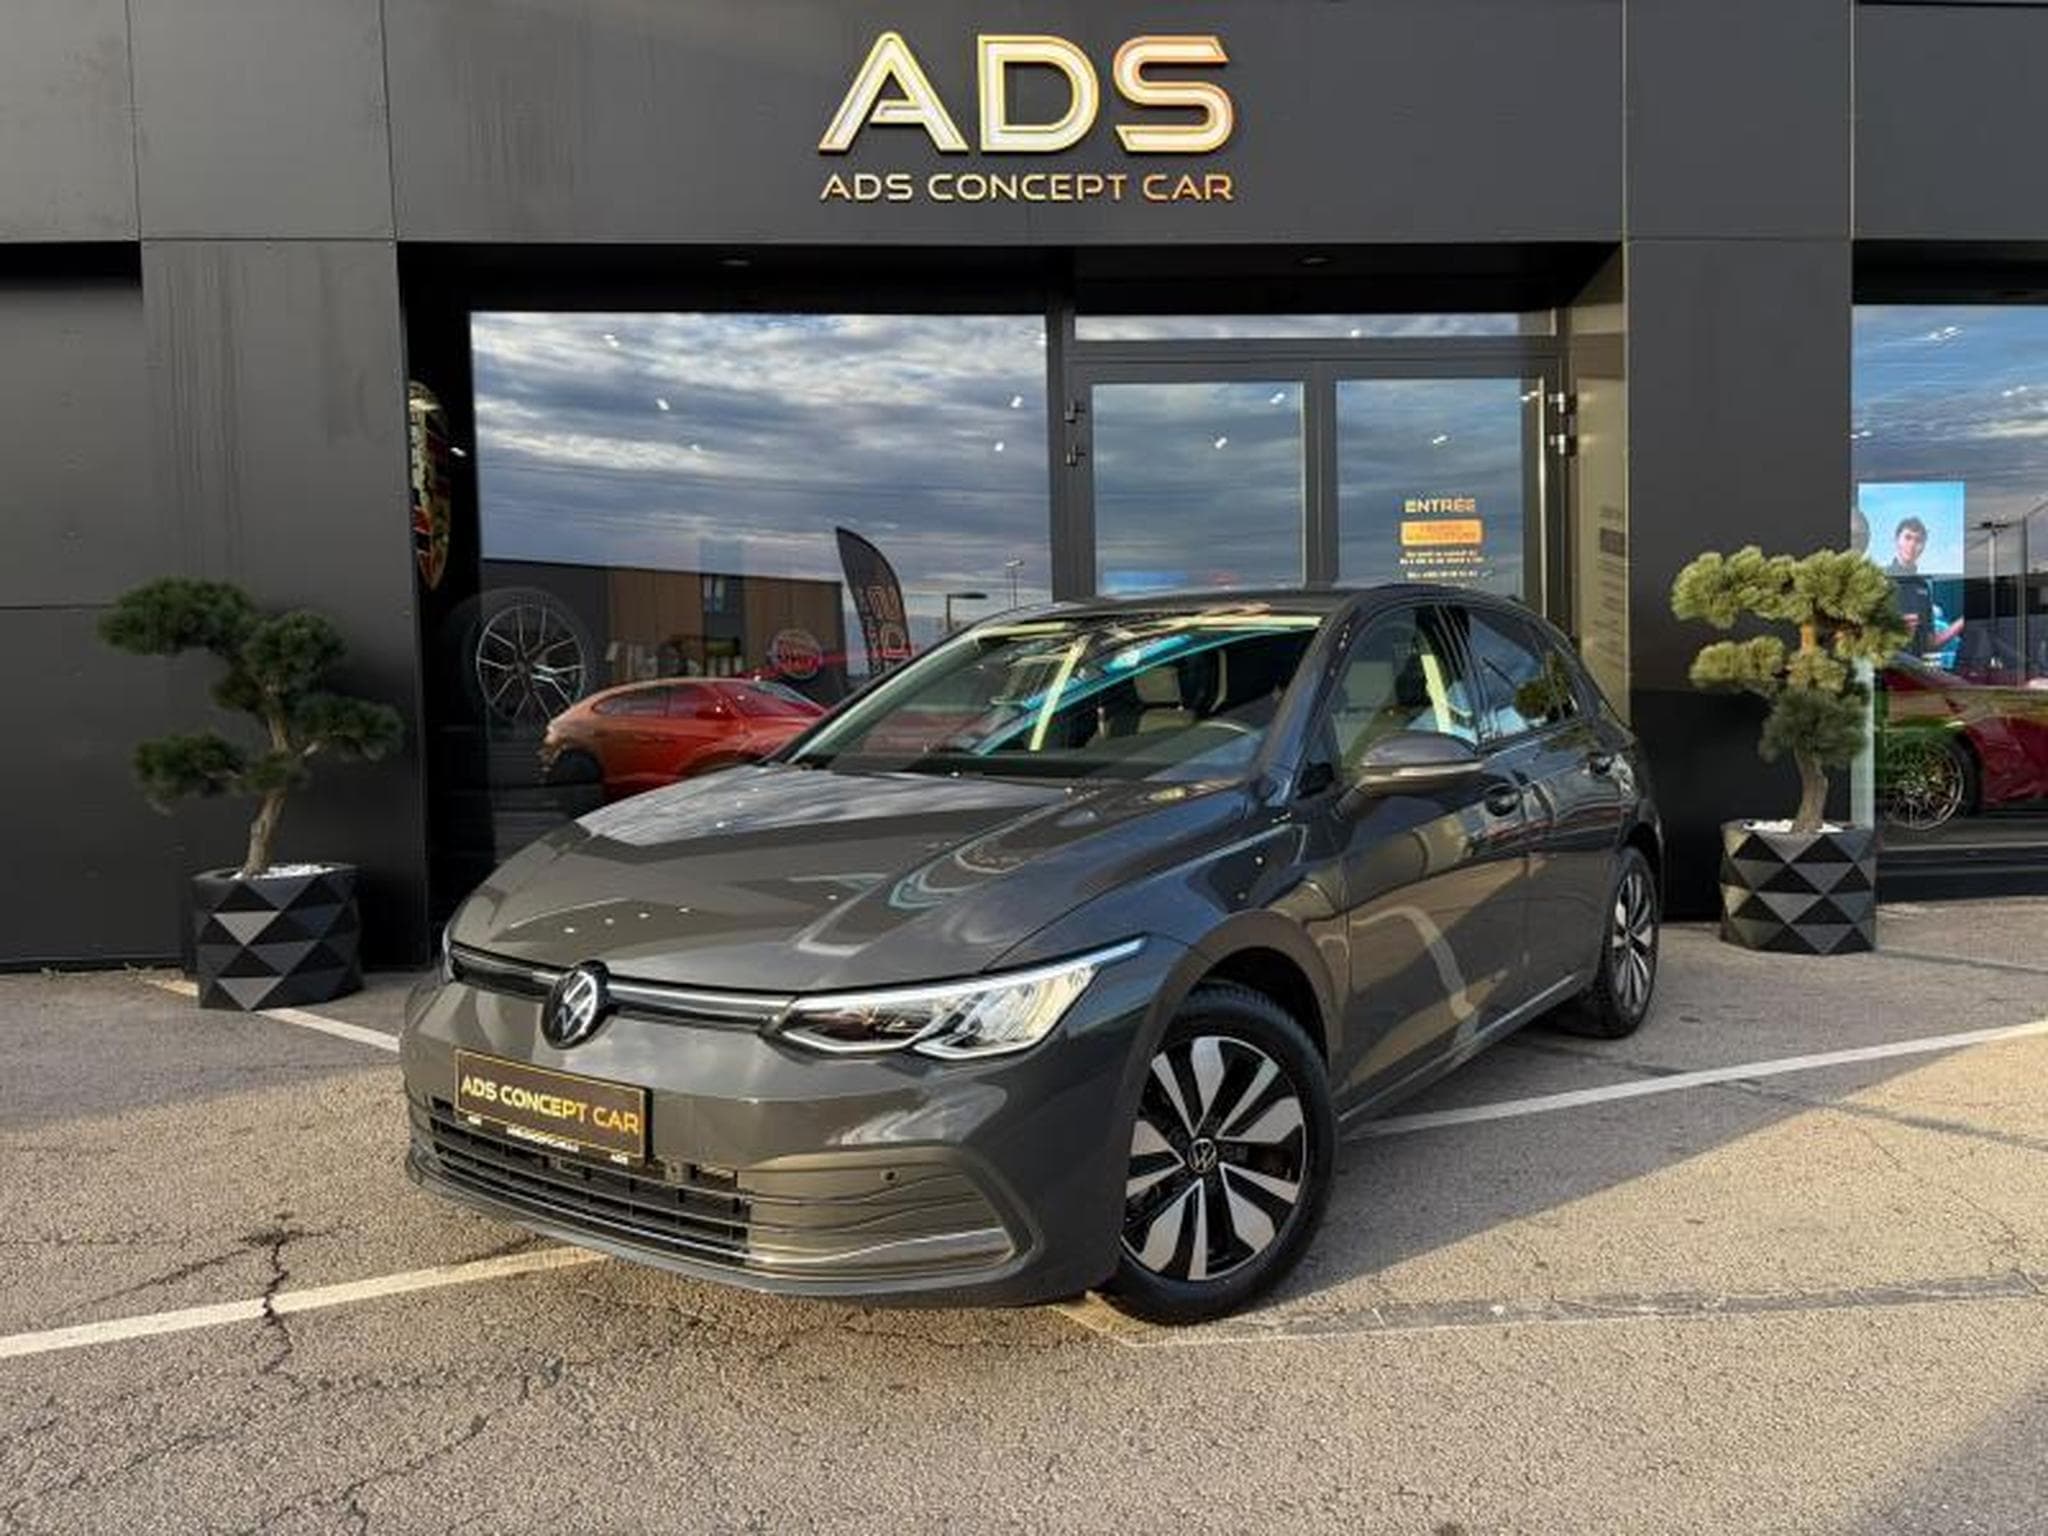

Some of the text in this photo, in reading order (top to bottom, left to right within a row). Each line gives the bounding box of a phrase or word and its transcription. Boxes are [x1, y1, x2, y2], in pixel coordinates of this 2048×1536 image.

[818, 31, 1234, 152] ADS
[820, 173, 1233, 201] ADS CONCEPT CAR
[460, 1074, 498, 1102] ADS
[500, 1084, 588, 1123] CONCEPT
[592, 1107, 639, 1135] CAR
